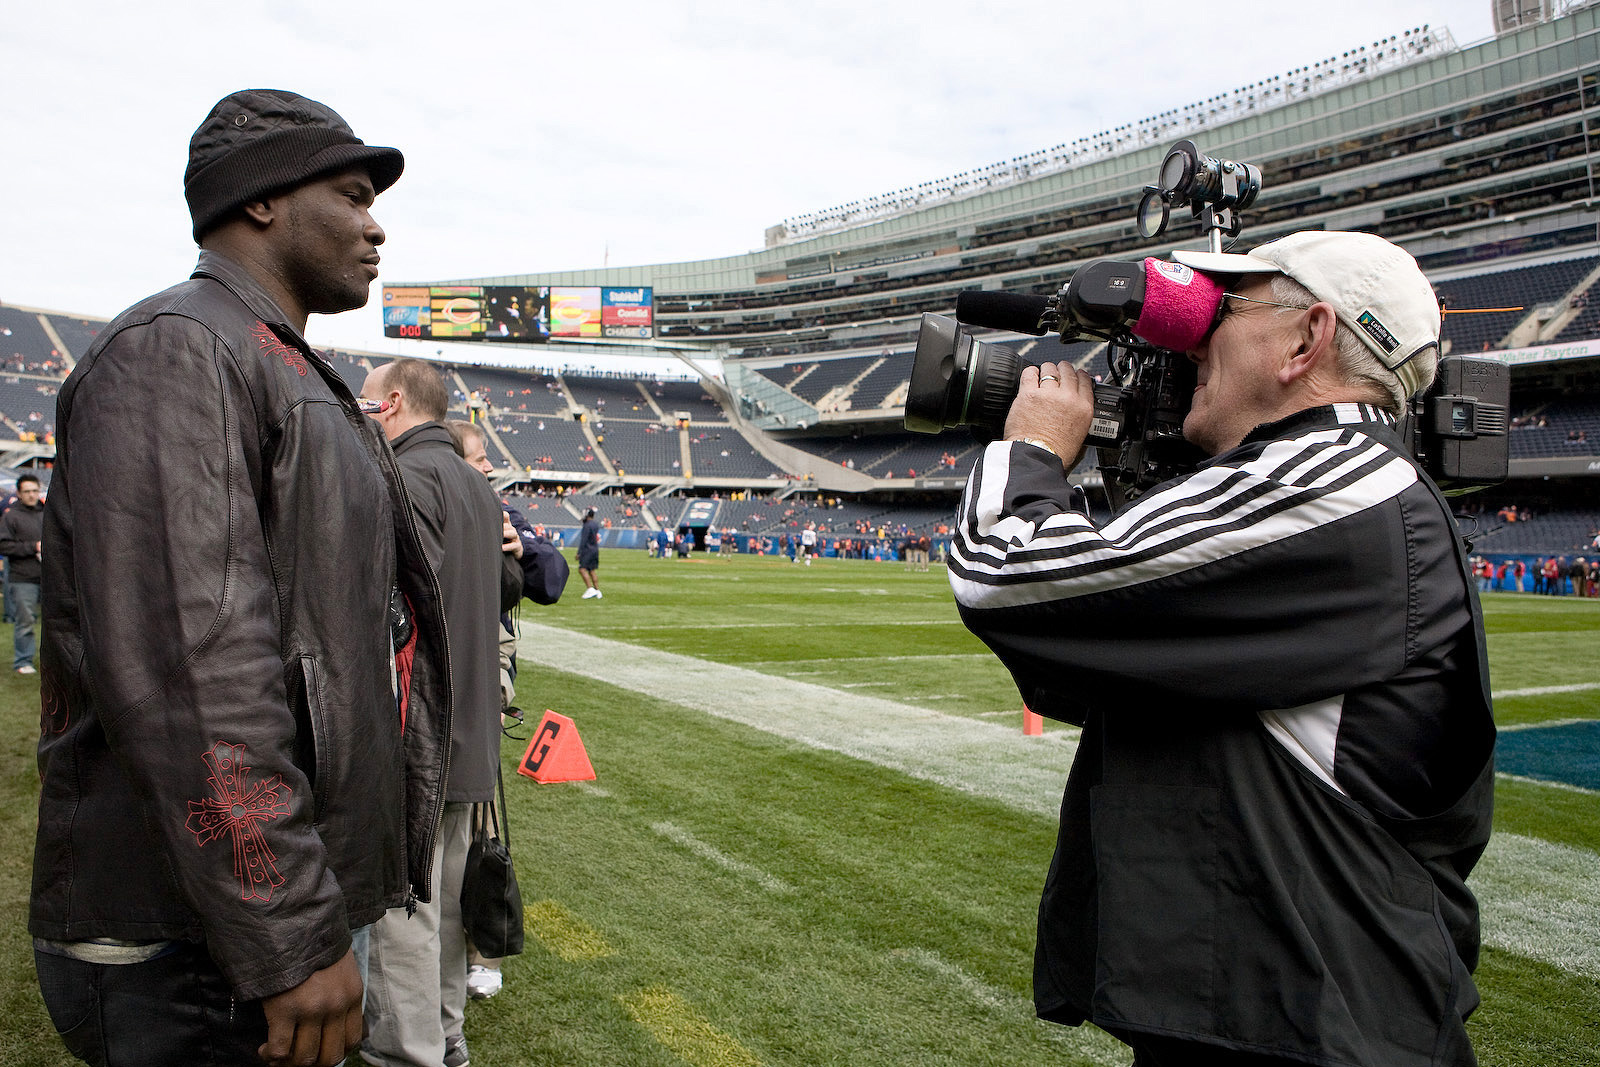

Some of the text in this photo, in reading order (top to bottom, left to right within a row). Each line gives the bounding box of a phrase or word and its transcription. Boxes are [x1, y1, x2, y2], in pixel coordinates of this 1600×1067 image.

[1499, 350, 1538, 361] Walter
[1543, 346, 1589, 360] Payton
[1097, 398, 1117, 407] Canon
[524, 720, 560, 773] G
